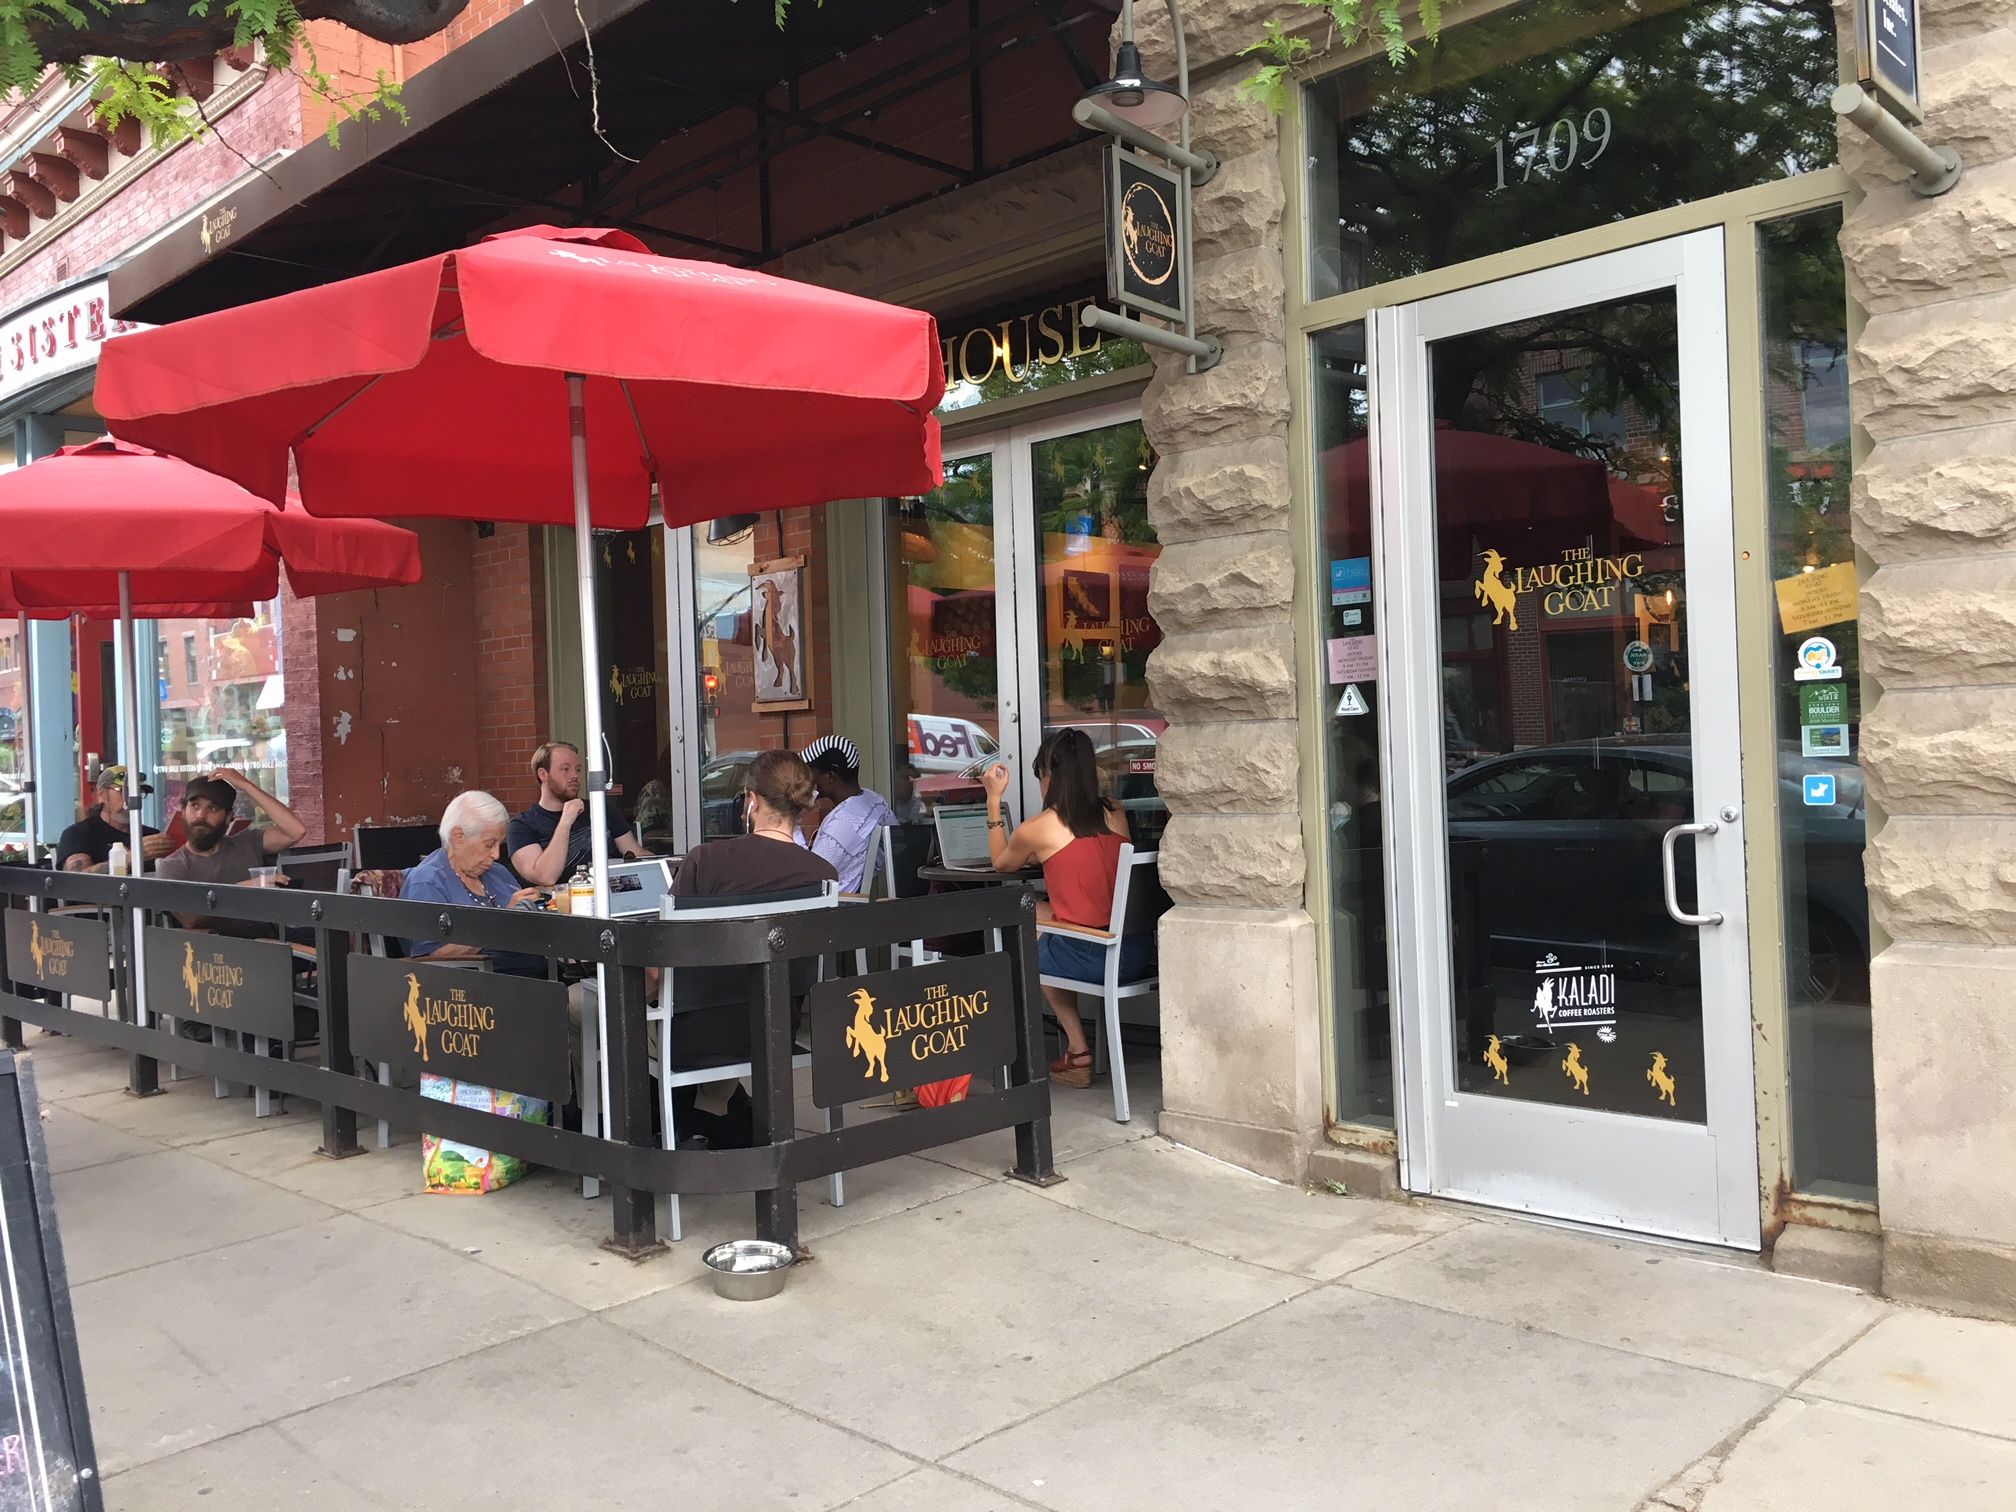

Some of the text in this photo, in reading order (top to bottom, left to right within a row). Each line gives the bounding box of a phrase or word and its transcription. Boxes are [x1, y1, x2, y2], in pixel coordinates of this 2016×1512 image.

[1883, 8, 1897, 37] Inc.
[1490, 107, 1611, 191] 1709
[209, 206, 237, 234] LAUGHING
[215, 224, 231, 243] GOAT
[1137, 221, 1173, 246] LAUGHING
[1145, 240, 1166, 258] GOAT
[1561, 547, 1591, 561] THE
[1515, 553, 1645, 593] LAUGHING
[1544, 586, 1615, 615] GOAT
[1082, 617, 1150, 636] LAUING
[925, 635, 981, 656] LAUGHING
[1098, 637, 1135, 653] GAT
[937, 654, 967, 670] GOAT
[630, 685, 652, 699] GOAT
[1808, 706, 1840, 714] BOULDER
[1132, 762, 1141, 770] NO
[52, 929, 61, 938] THE
[40, 936, 74, 957] LAUGHING
[49, 959, 67, 976] GOAT
[213, 953, 224, 964] THE
[197, 960, 243, 987] LAUGHING
[207, 987, 234, 1009] GOAT
[449, 988, 466, 1002] THE
[923, 984, 949, 1000] THE
[1557, 973, 1615, 1007] KALADI
[425, 997, 495, 1032] LAUGHING
[883, 990, 989, 1039] LAUGHING
[1558, 1006, 1615, 1017] COFFEE ROASTERS
[441, 1029, 480, 1057] GOAT
[911, 1024, 969, 1060] GOAT
